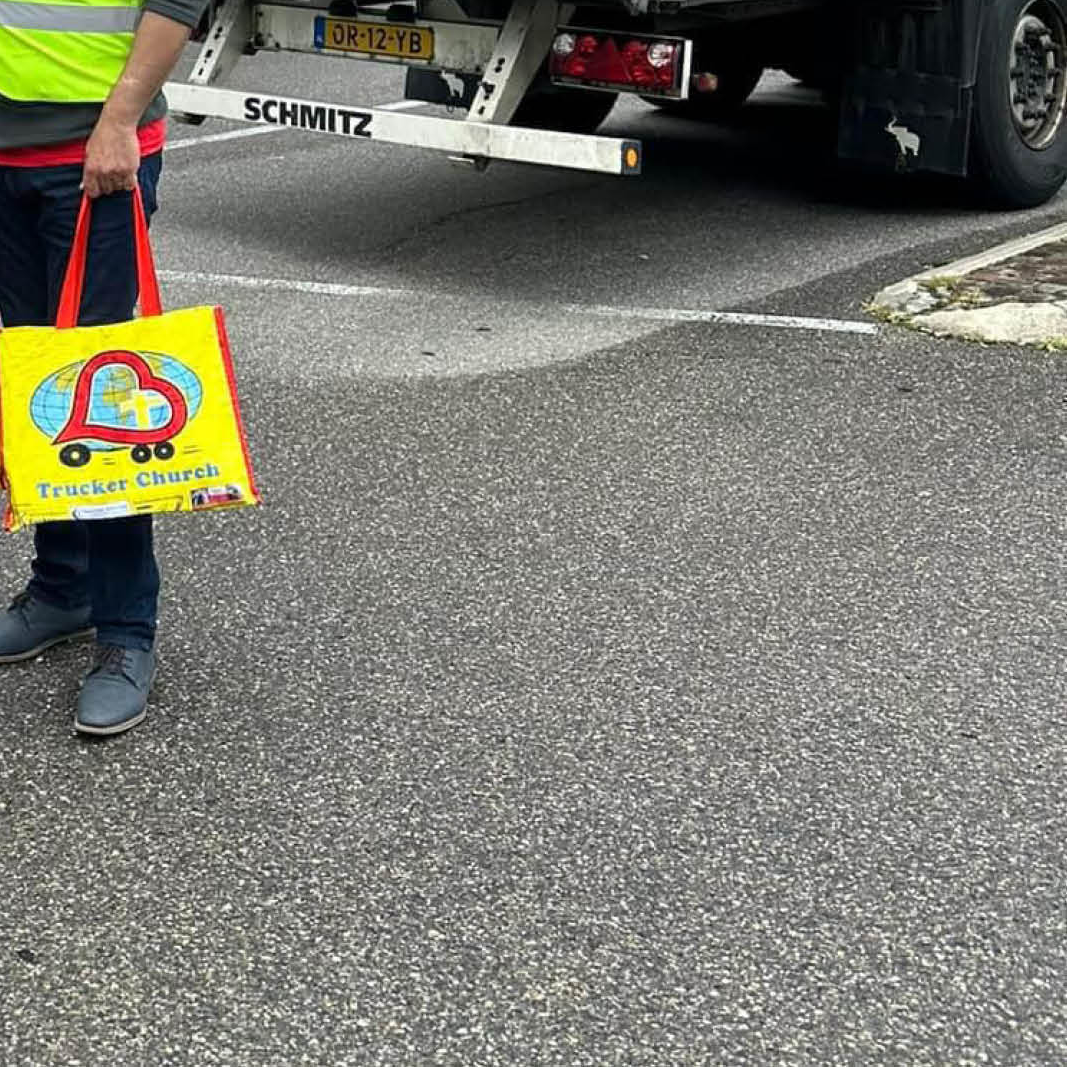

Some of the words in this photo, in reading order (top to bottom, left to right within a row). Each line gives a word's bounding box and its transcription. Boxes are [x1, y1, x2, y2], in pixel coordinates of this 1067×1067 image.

[333, 23, 422, 53] OR-12-YB
[244, 97, 372, 138] SCHMITZ
[37, 479, 128, 499] Trucker
[136, 462, 220, 488] Church
